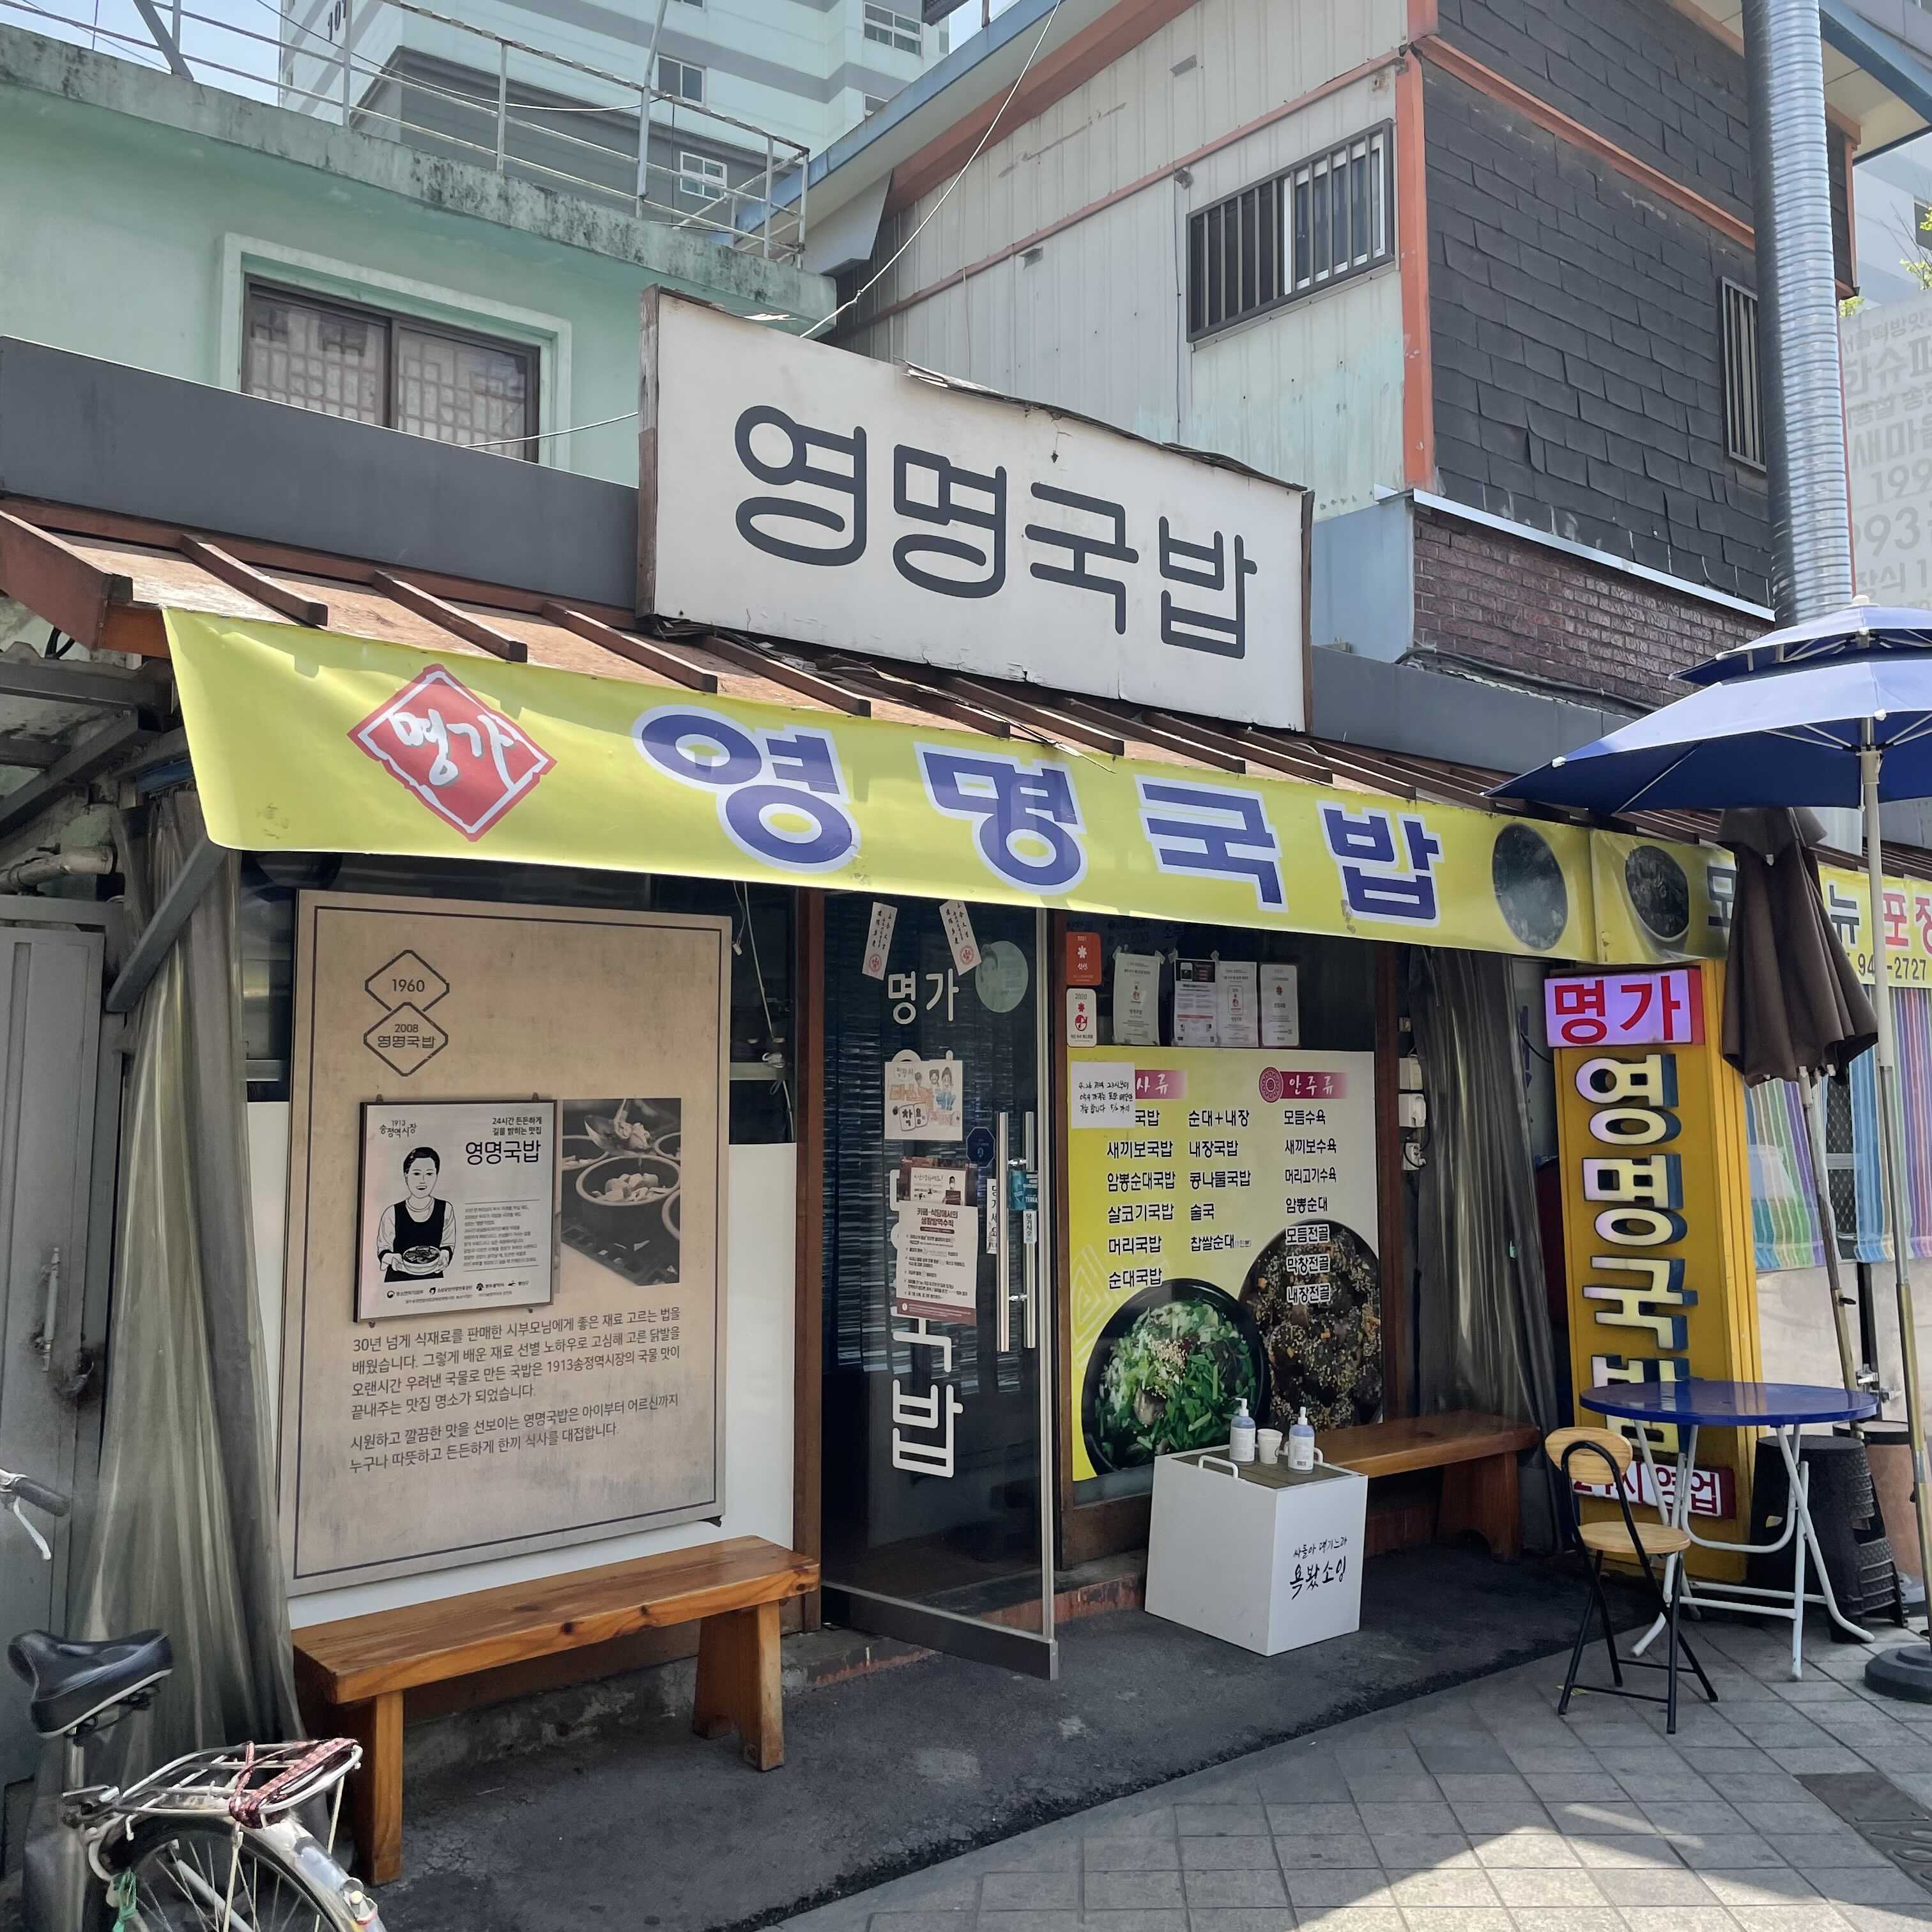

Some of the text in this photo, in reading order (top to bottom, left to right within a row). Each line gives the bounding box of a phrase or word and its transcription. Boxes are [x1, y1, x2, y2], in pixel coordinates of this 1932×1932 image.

[735, 405, 1257, 659] 영명국밥
[1853, 507, 1920, 557] 93
[387, 709, 528, 788] 명가
[641, 710, 1439, 920] 영명국밥
[1859, 954, 1926, 981] 94-2727
[392, 979, 425, 992] 1960
[889, 969, 959, 1024] 명가
[1555, 976, 1680, 1044] 명가
[394, 1023, 419, 1032] 2008
[378, 1035, 436, 1048] 영명국밥
[1289, 1076, 1333, 1094] 안주류
[492, 1116, 542, 1126] 24시간 든든하게
[1188, 1110, 1249, 1128] 순대+내장
[1284, 1110, 1326, 1125] 모듬수육
[379, 1124, 417, 1138] 송정역시장
[528, 1126, 542, 1135] 맛집
[466, 1140, 541, 1165] 영명국밥
[1107, 1140, 1238, 1159] 새끼보국밥 내장국밥
[1285, 1138, 1337, 1154] 새끼보수육
[1108, 1171, 1251, 1192] 암뽕순대국밥 콩나물국밥
[1285, 1168, 1337, 1184] 머리고기수육
[1108, 1204, 1215, 1223] 살코기국밥 술국
[1286, 1197, 1328, 1213] 암뽕순대
[1109, 1236, 1161, 1255] 머리국밥
[1191, 1234, 1234, 1252] 찹쌀순대
[1287, 1227, 1329, 1243] 모듬전골
[1287, 1256, 1329, 1275] 막창전골
[1109, 1269, 1162, 1289] 순대국밥
[1287, 1285, 1330, 1303] 내장전골
[353, 1307, 680, 1352] 30년 넘게 식재료를 판매한 시부모님에게 좋은 재료 고르는 법을
[353, 1326, 680, 1374] 배웠습니다. 그렇게 배운 재료 선별 노하우로 고심해 고른 닭발을
[353, 1346, 680, 1397] 오랜시간 우려낸 국물로 만든 국밥은 1913송정역시장의 국물 맛이
[352, 1384, 535, 1420] 끝내주는 맛집 명소가 되었습니다.
[351, 1393, 678, 1450] 시원하고 깔끔한 맛을 선보이는 영명국밥은 아이부터 어르신까지
[350, 1422, 618, 1473] 누구나 따뜻하고 든든하게 한끼 식사를 대접합니다.
